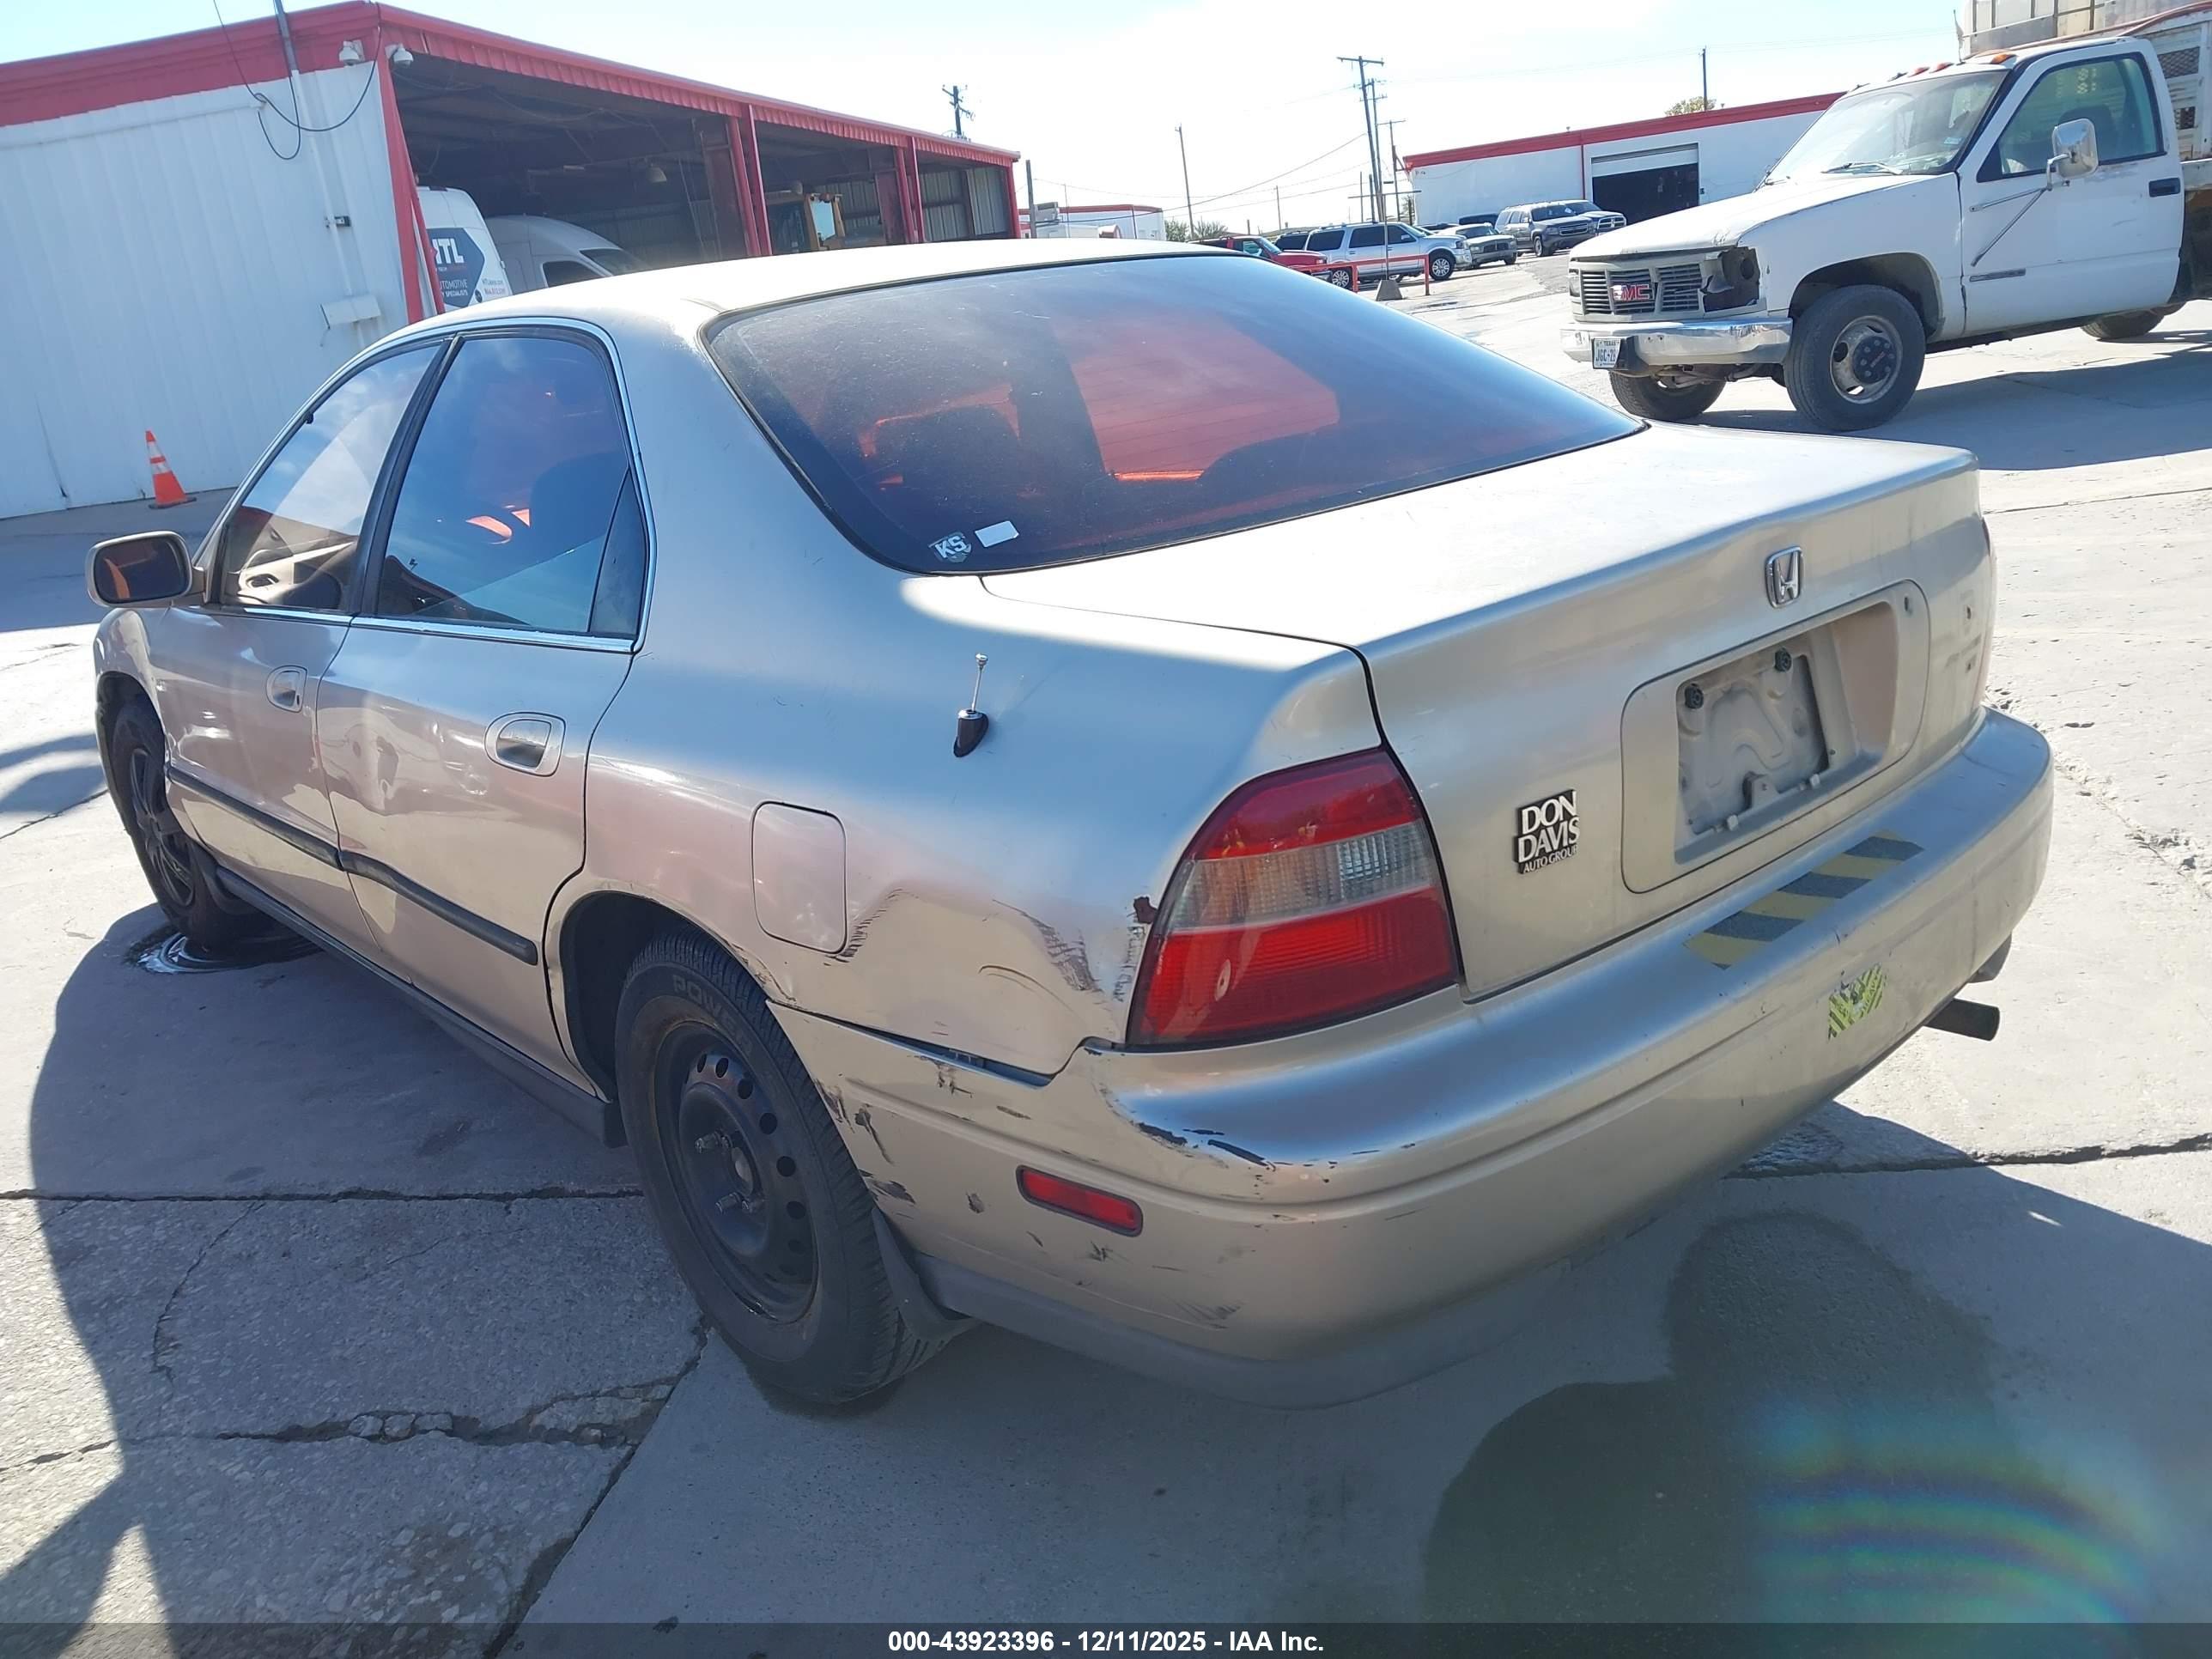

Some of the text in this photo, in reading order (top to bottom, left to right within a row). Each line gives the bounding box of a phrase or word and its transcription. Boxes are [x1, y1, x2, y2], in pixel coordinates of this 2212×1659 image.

[934, 535, 967, 558] KS
[1522, 791, 1577, 835] DON
[1517, 817, 1580, 863] DAVIS
